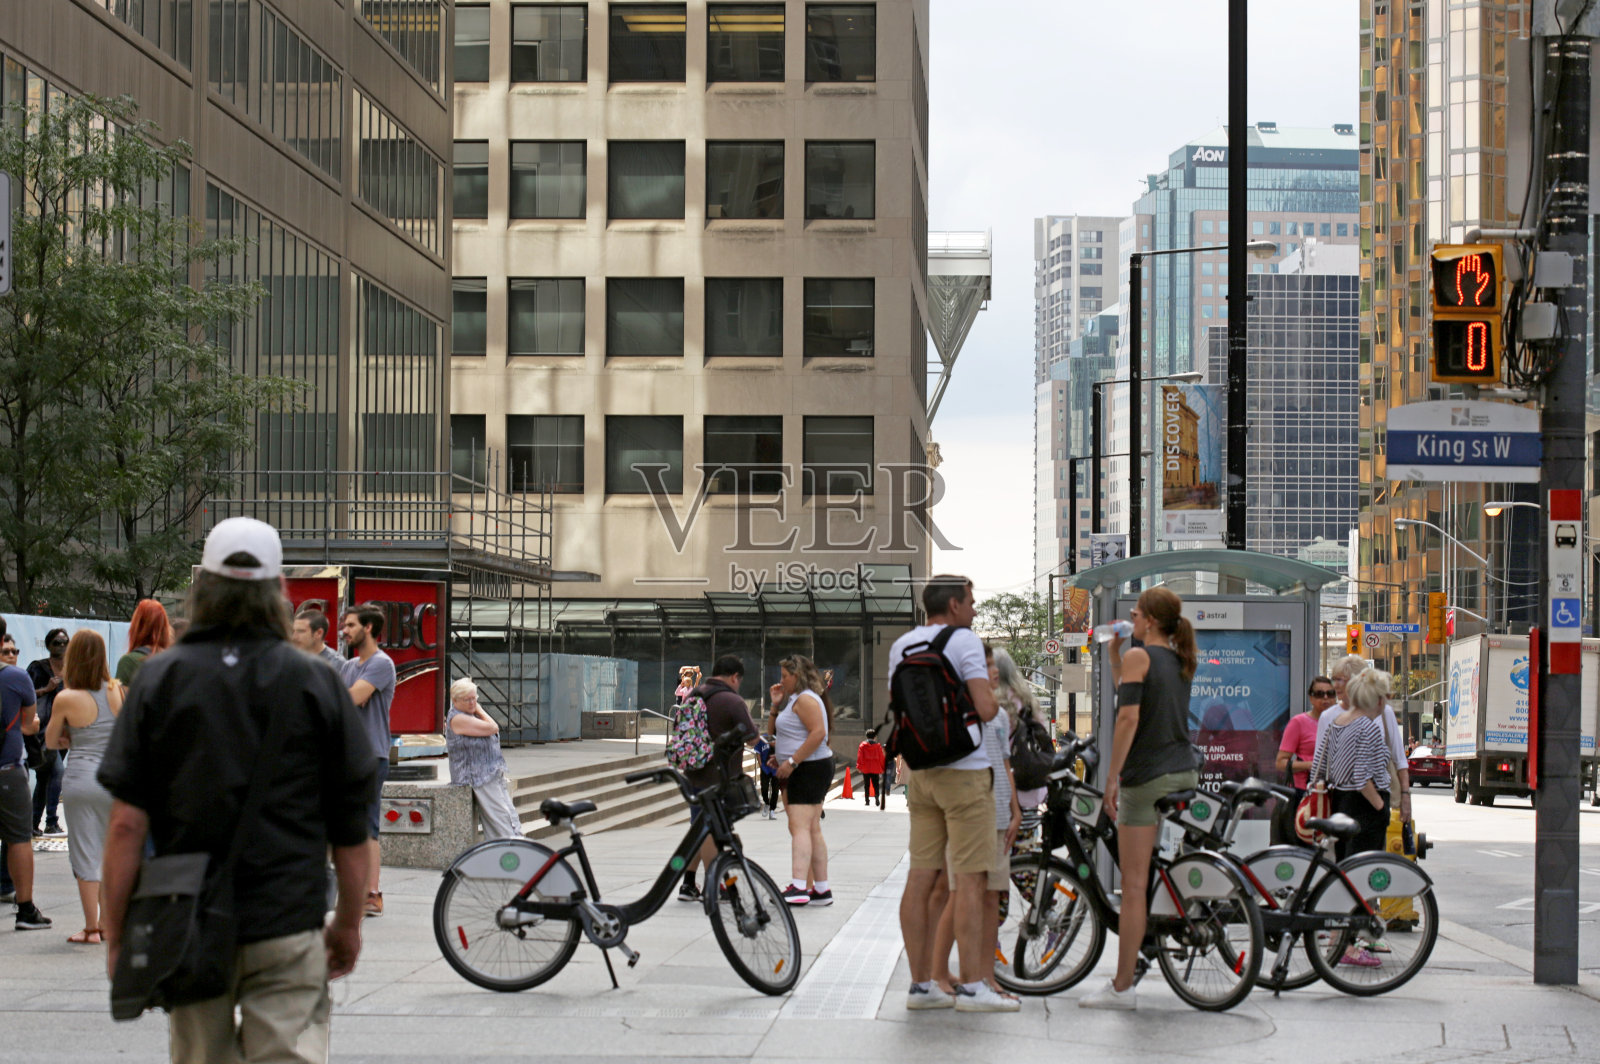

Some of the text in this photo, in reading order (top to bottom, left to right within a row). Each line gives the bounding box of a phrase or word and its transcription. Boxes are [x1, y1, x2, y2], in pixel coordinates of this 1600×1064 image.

[1192, 147, 1225, 162] AON
[1166, 391, 1180, 471] DISCOVER
[1417, 434, 1511, 463] King St W
[1562, 578, 1569, 587] 6
[1206, 611, 1227, 619] astral
[1370, 624, 1402, 632] Wellington
[1208, 649, 1220, 657] ON
[1221, 649, 1245, 657] TODAY
[1219, 657, 1255, 665] DISTRICT?
[1190, 685, 1251, 699] @MyTOFD
[1209, 745, 1226, 753] AND
[1211, 753, 1243, 761] UPDATES
[1204, 773, 1213, 781] up
[1215, 772, 1223, 780] at
